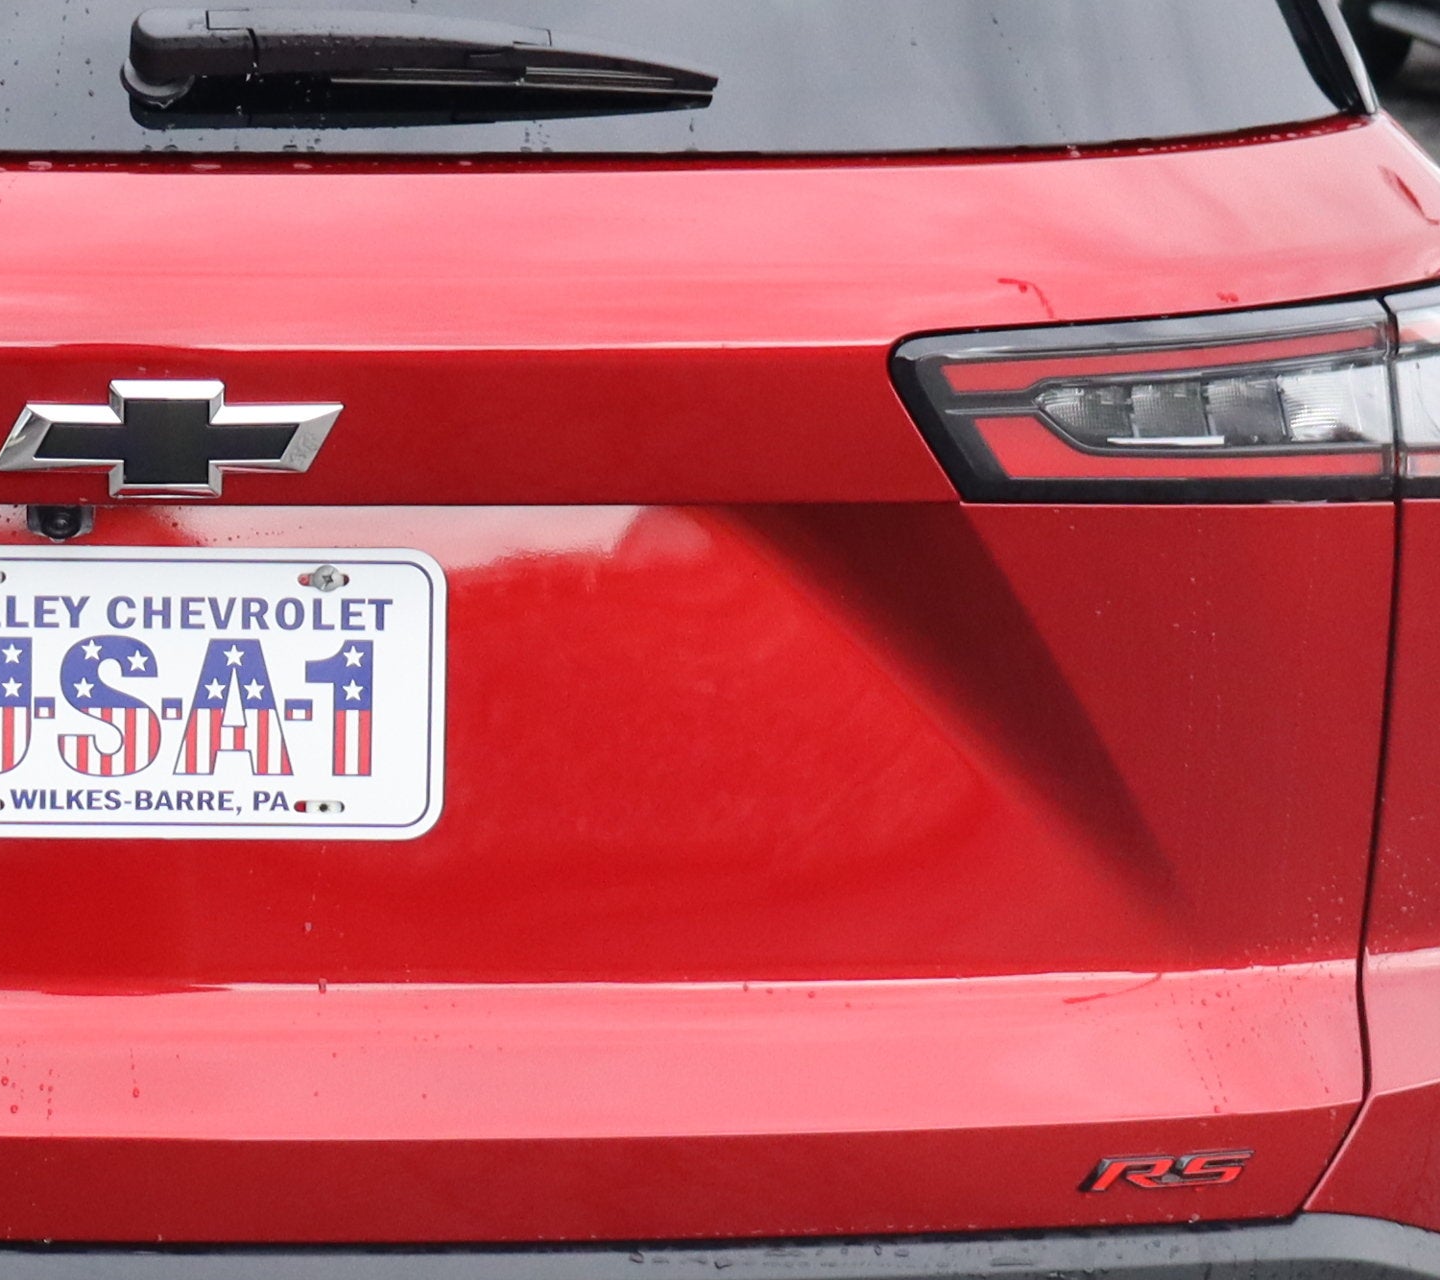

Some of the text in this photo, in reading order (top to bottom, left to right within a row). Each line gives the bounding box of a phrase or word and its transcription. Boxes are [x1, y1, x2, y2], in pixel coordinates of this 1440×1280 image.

[106, 596, 394, 631] CHEVROLET
[10, 788, 291, 815] WILKES-BARRE, PA
[1077, 1149, 1255, 1192] RS
